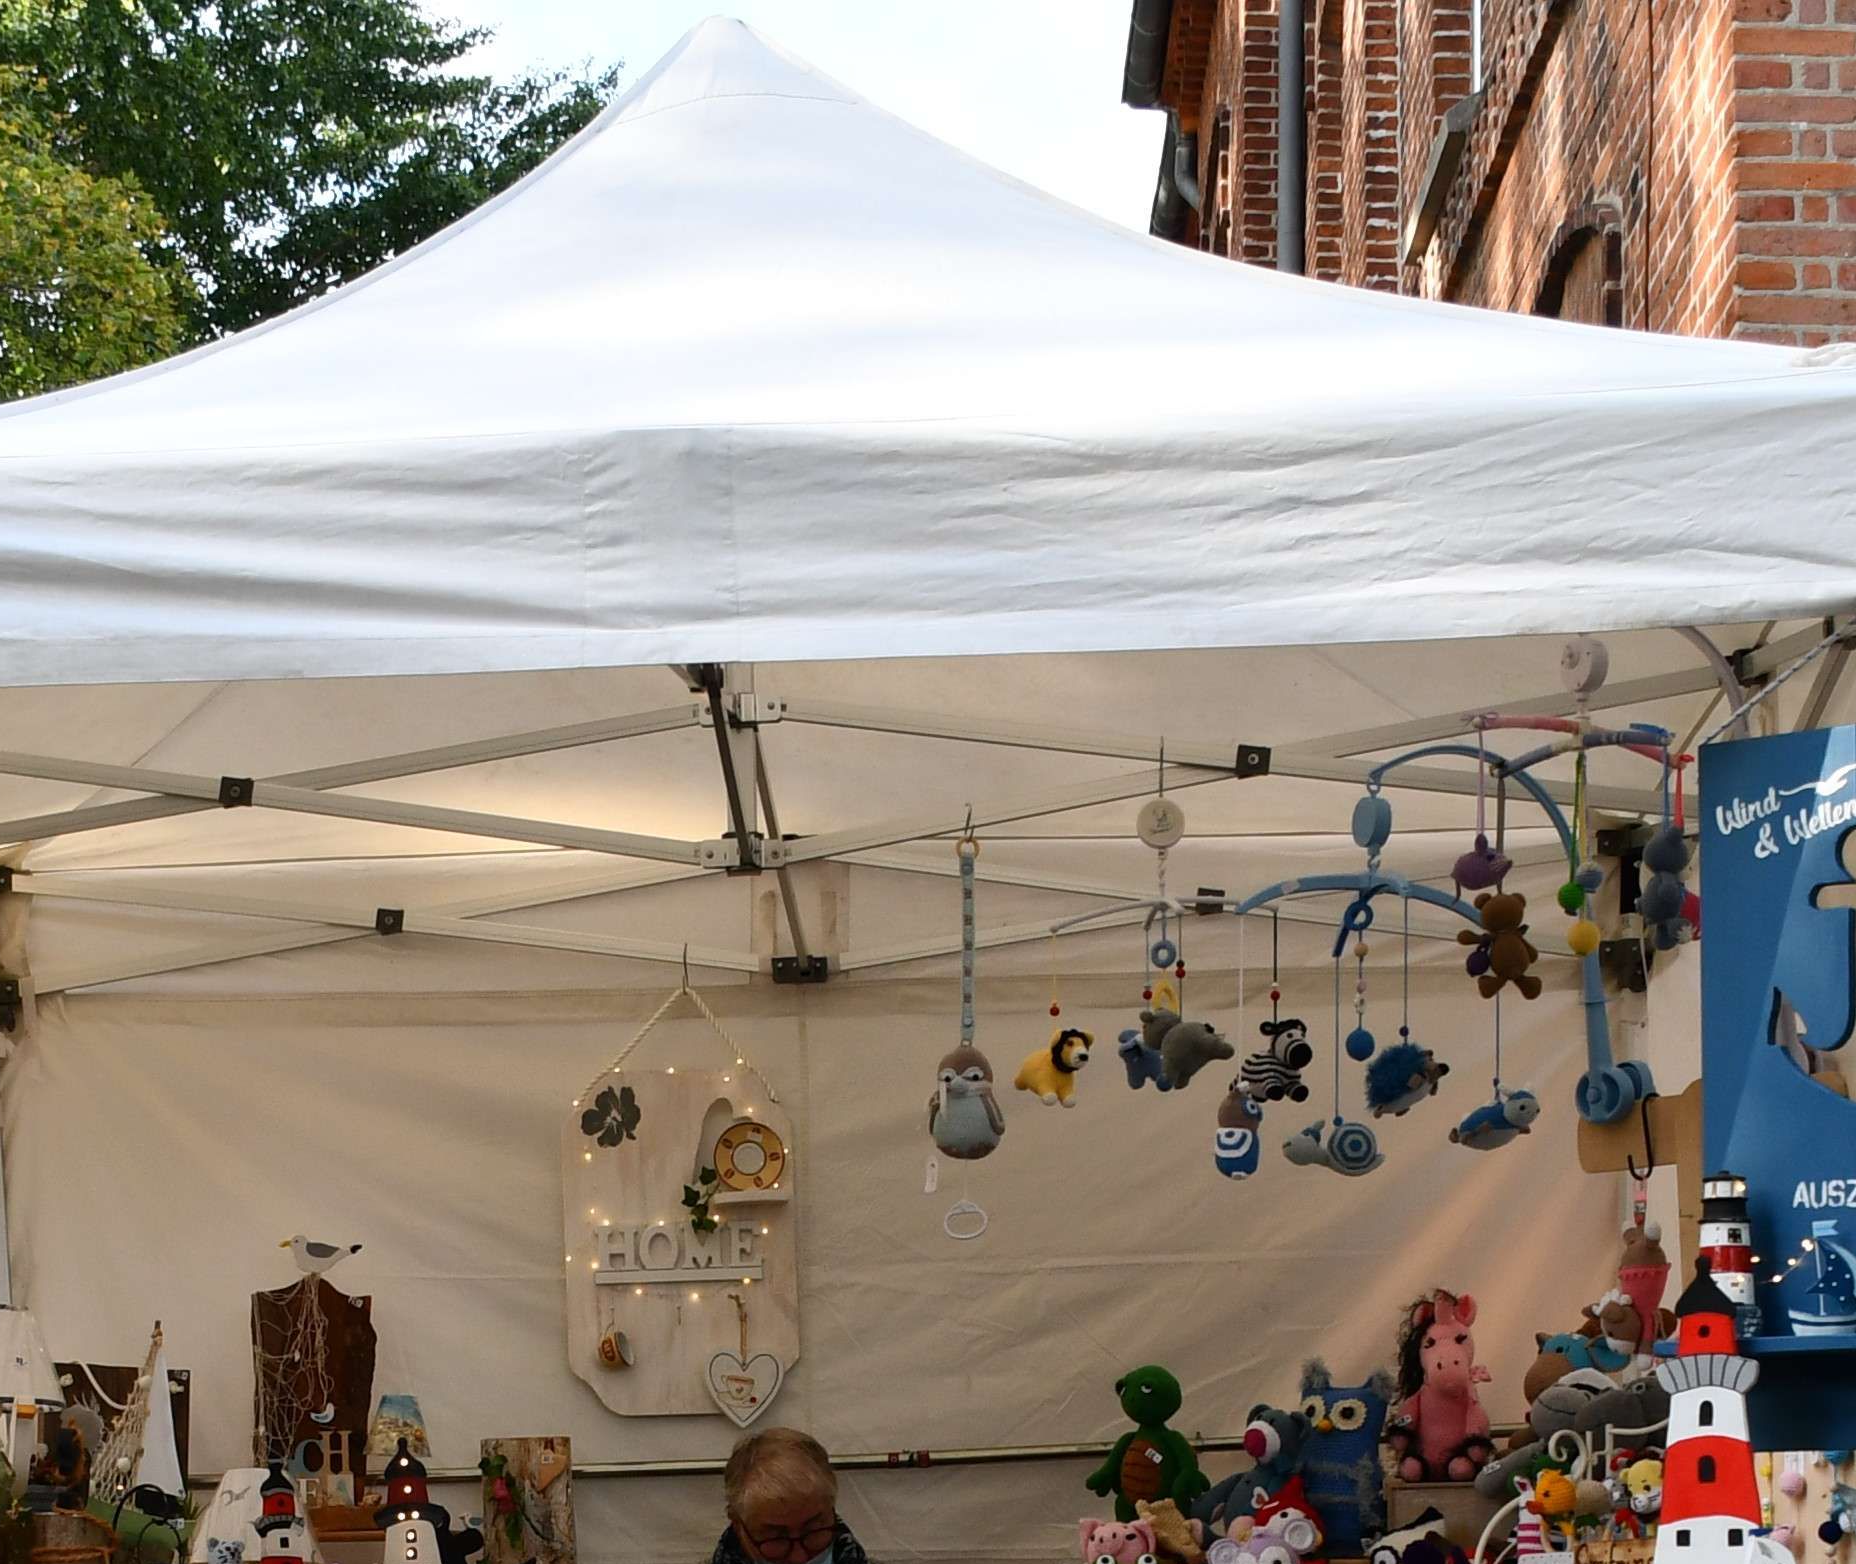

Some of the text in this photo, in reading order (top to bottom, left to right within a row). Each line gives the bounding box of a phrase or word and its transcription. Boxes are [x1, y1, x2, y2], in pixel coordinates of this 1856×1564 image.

[1716, 786, 1782, 836] Wind
[1754, 822, 1780, 859] &
[596, 1220, 764, 1272] HOME
